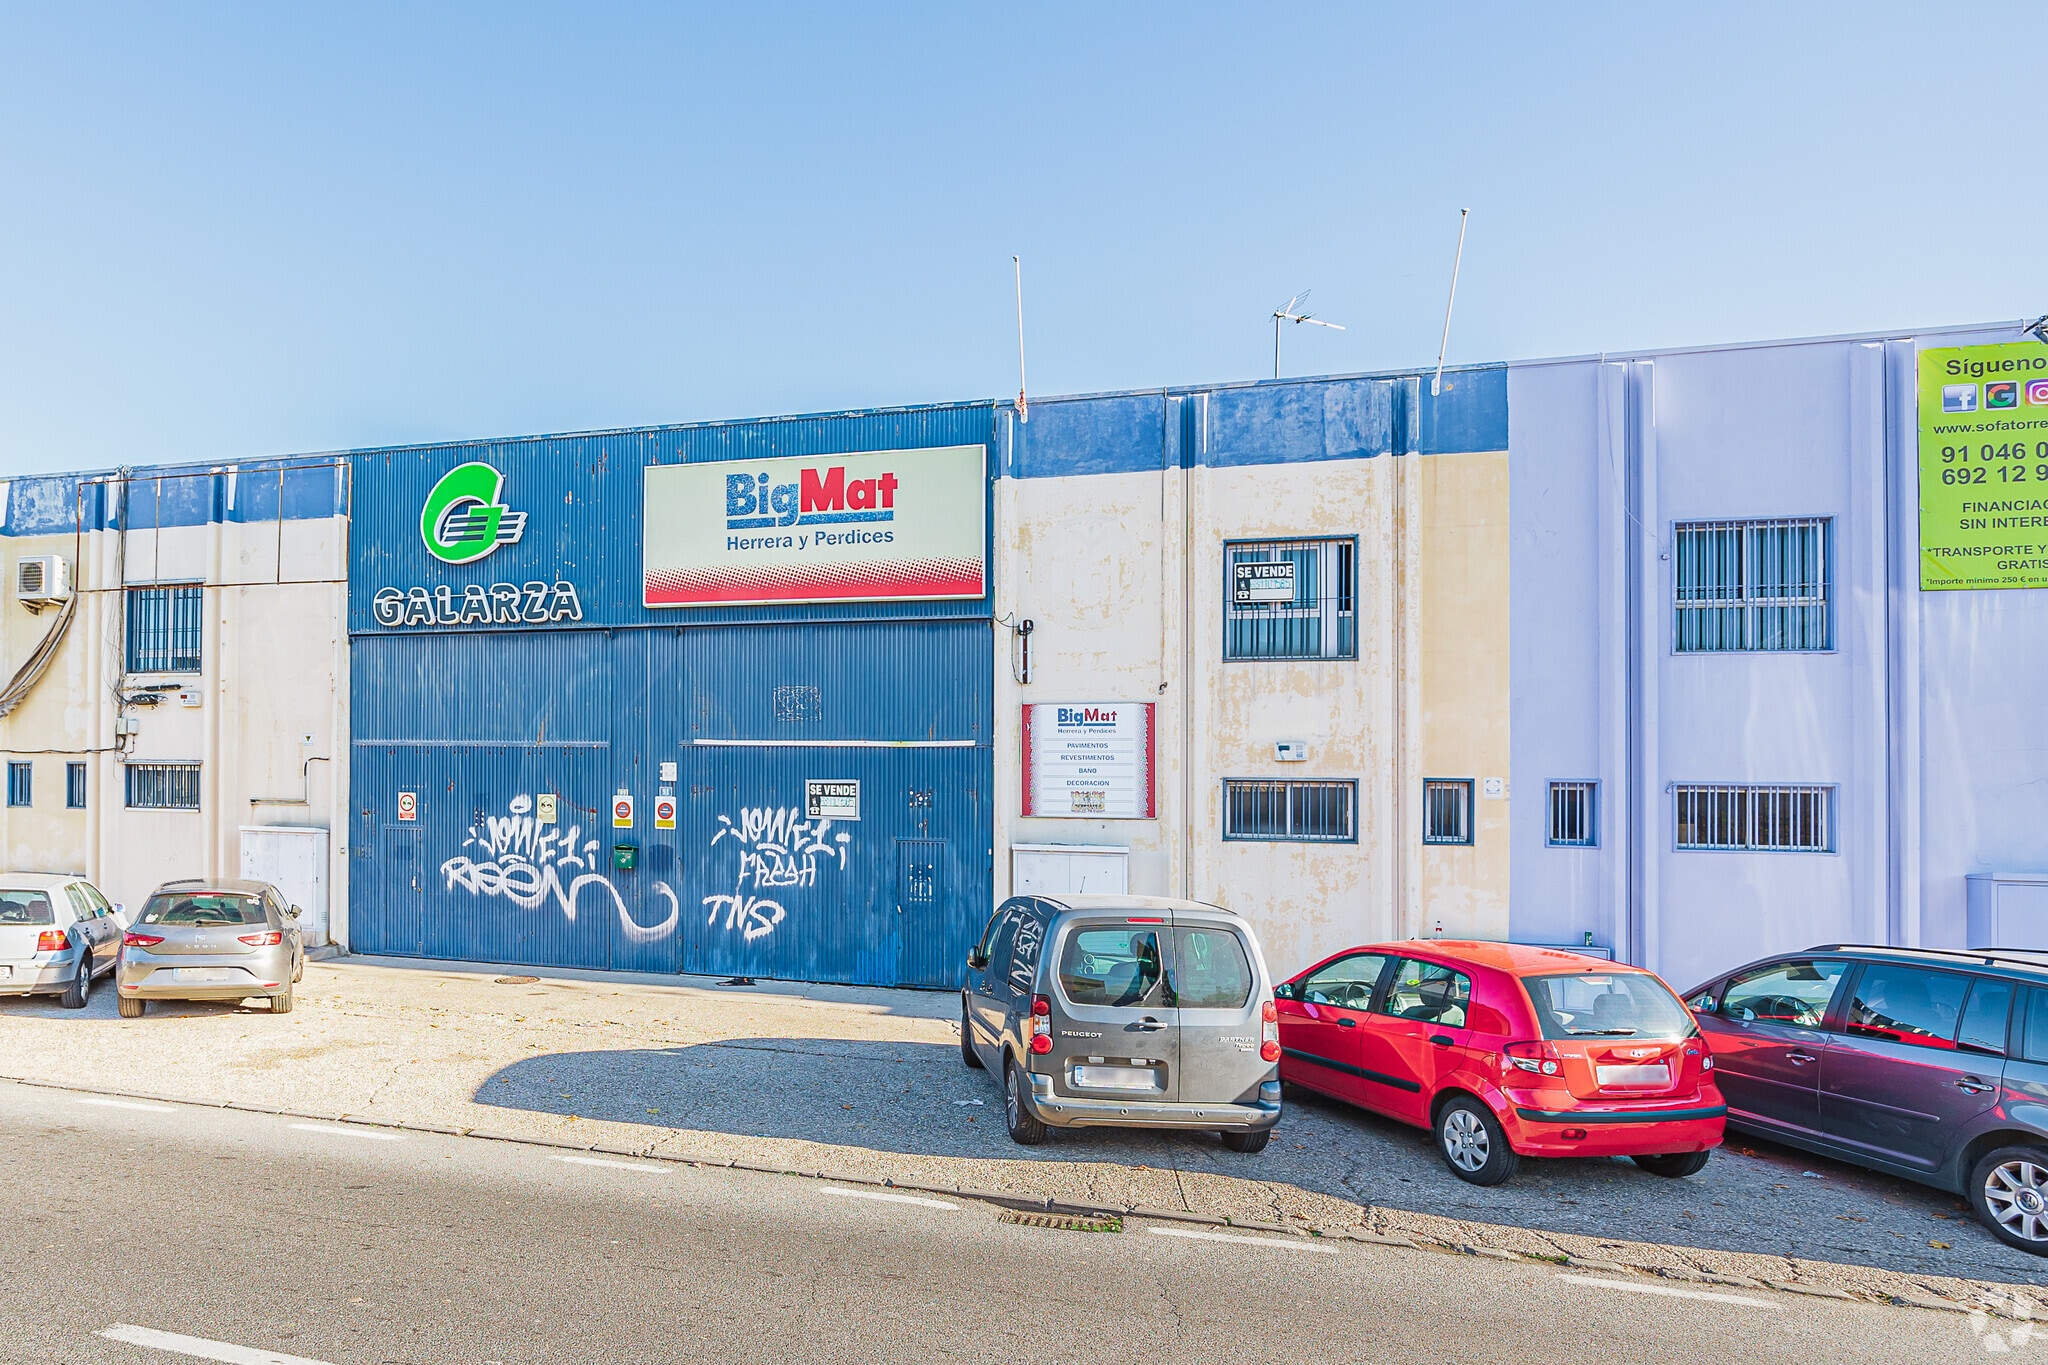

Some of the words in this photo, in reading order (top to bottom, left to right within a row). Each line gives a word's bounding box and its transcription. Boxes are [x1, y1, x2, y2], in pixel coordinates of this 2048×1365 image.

[1934, 419, 2048, 434] www.sofatorre
[1942, 446, 1968, 463] 91
[1981, 442, 2026, 461] 046
[1942, 467, 1987, 485] 692
[1997, 464, 2026, 483] 12
[726, 467, 898, 527] BigMat
[1960, 519, 1986, 529] SIN
[727, 536, 793, 550] Herrera
[799, 535, 808, 550] y
[815, 529, 894, 546] Perdices
[2038, 544, 2047, 554] Y
[1237, 567, 1252, 578] SE
[1254, 565, 1293, 577] VENDE
[373, 581, 583, 626] GALARZA
[1057, 707, 1117, 727] BigMat
[810, 784, 822, 796] SE
[824, 785, 856, 796] VENDE
[1061, 1030, 1103, 1038] PEUGEOT
